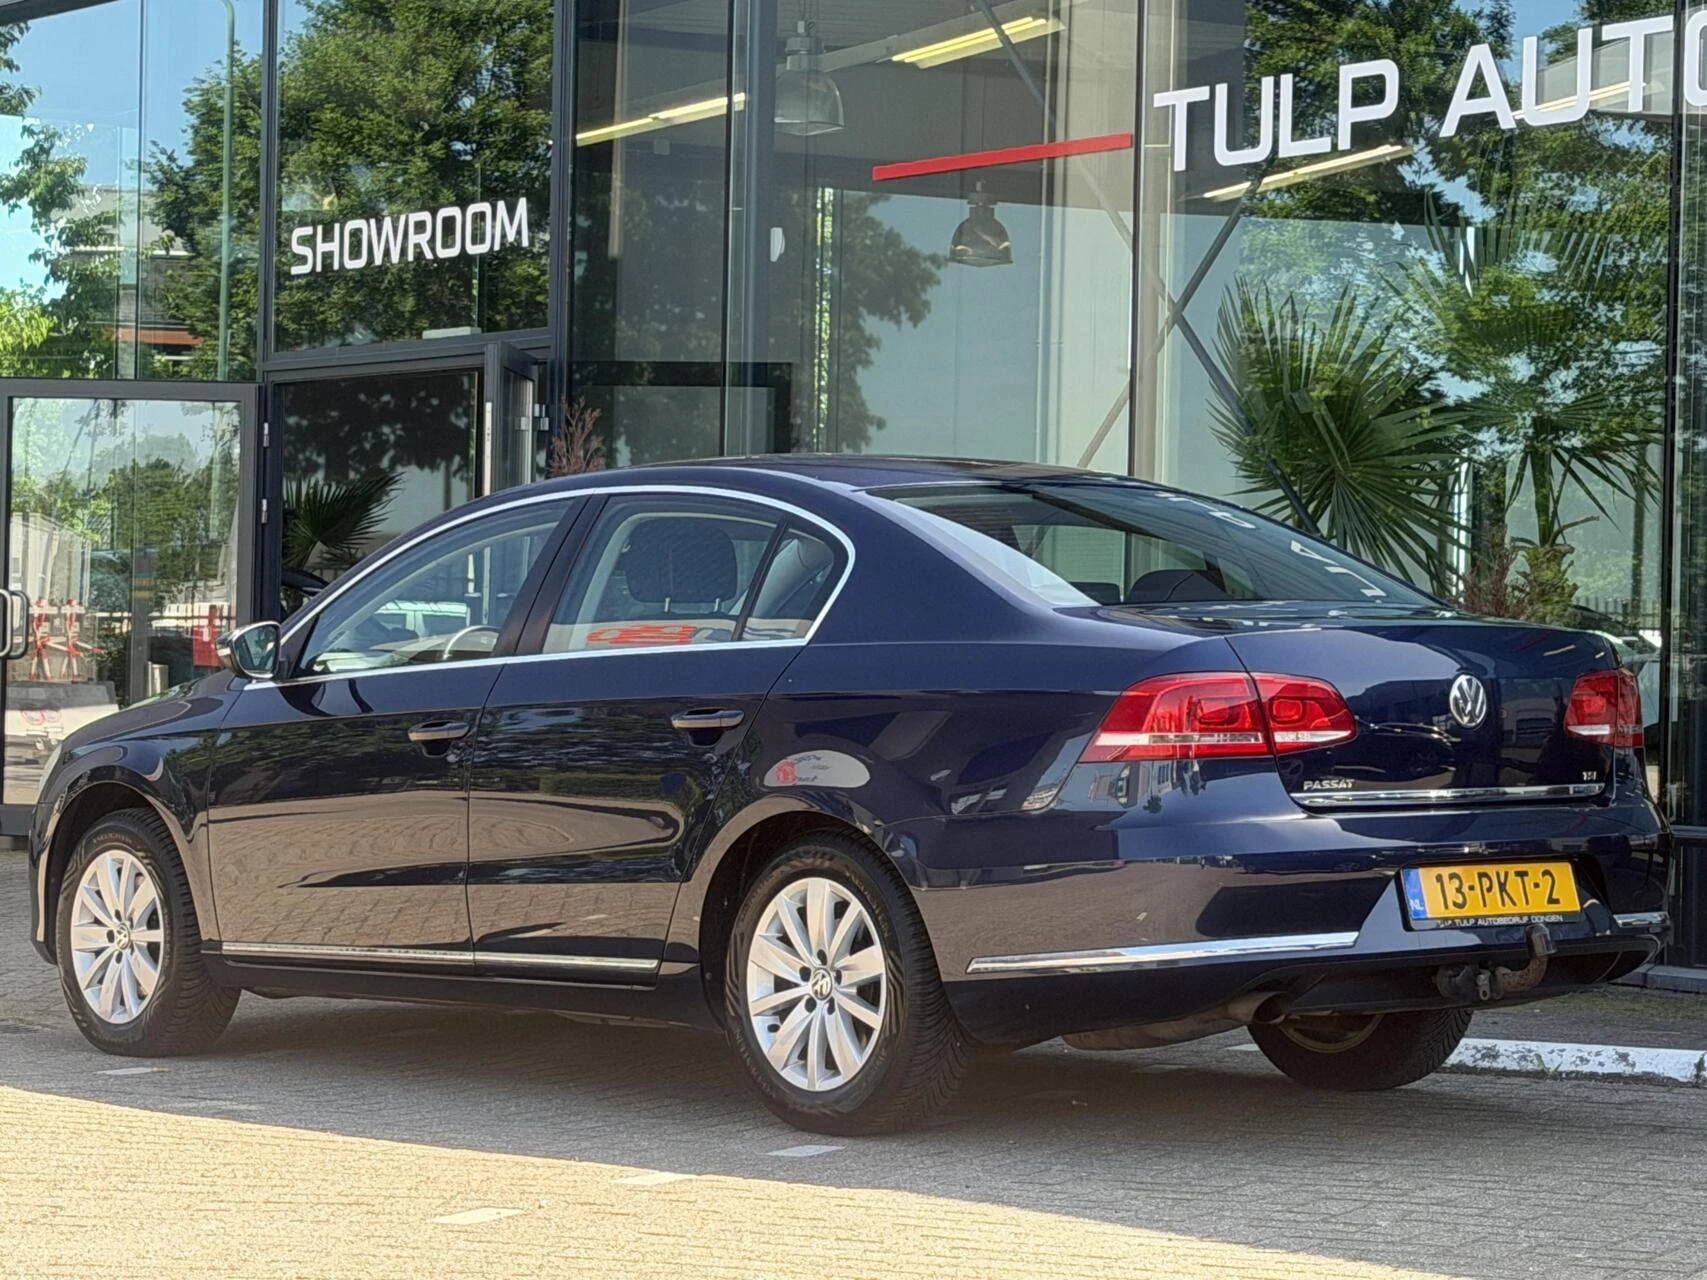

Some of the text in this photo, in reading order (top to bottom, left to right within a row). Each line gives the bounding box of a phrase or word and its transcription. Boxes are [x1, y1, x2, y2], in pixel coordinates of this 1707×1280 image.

[1153, 58, 1399, 172] TULP
[290, 197, 529, 275] SHOWROOM
[1303, 778, 1355, 791] PASSAT
[1409, 898, 1424, 911] NL
[1434, 868, 1561, 911] 13-PKT-2
